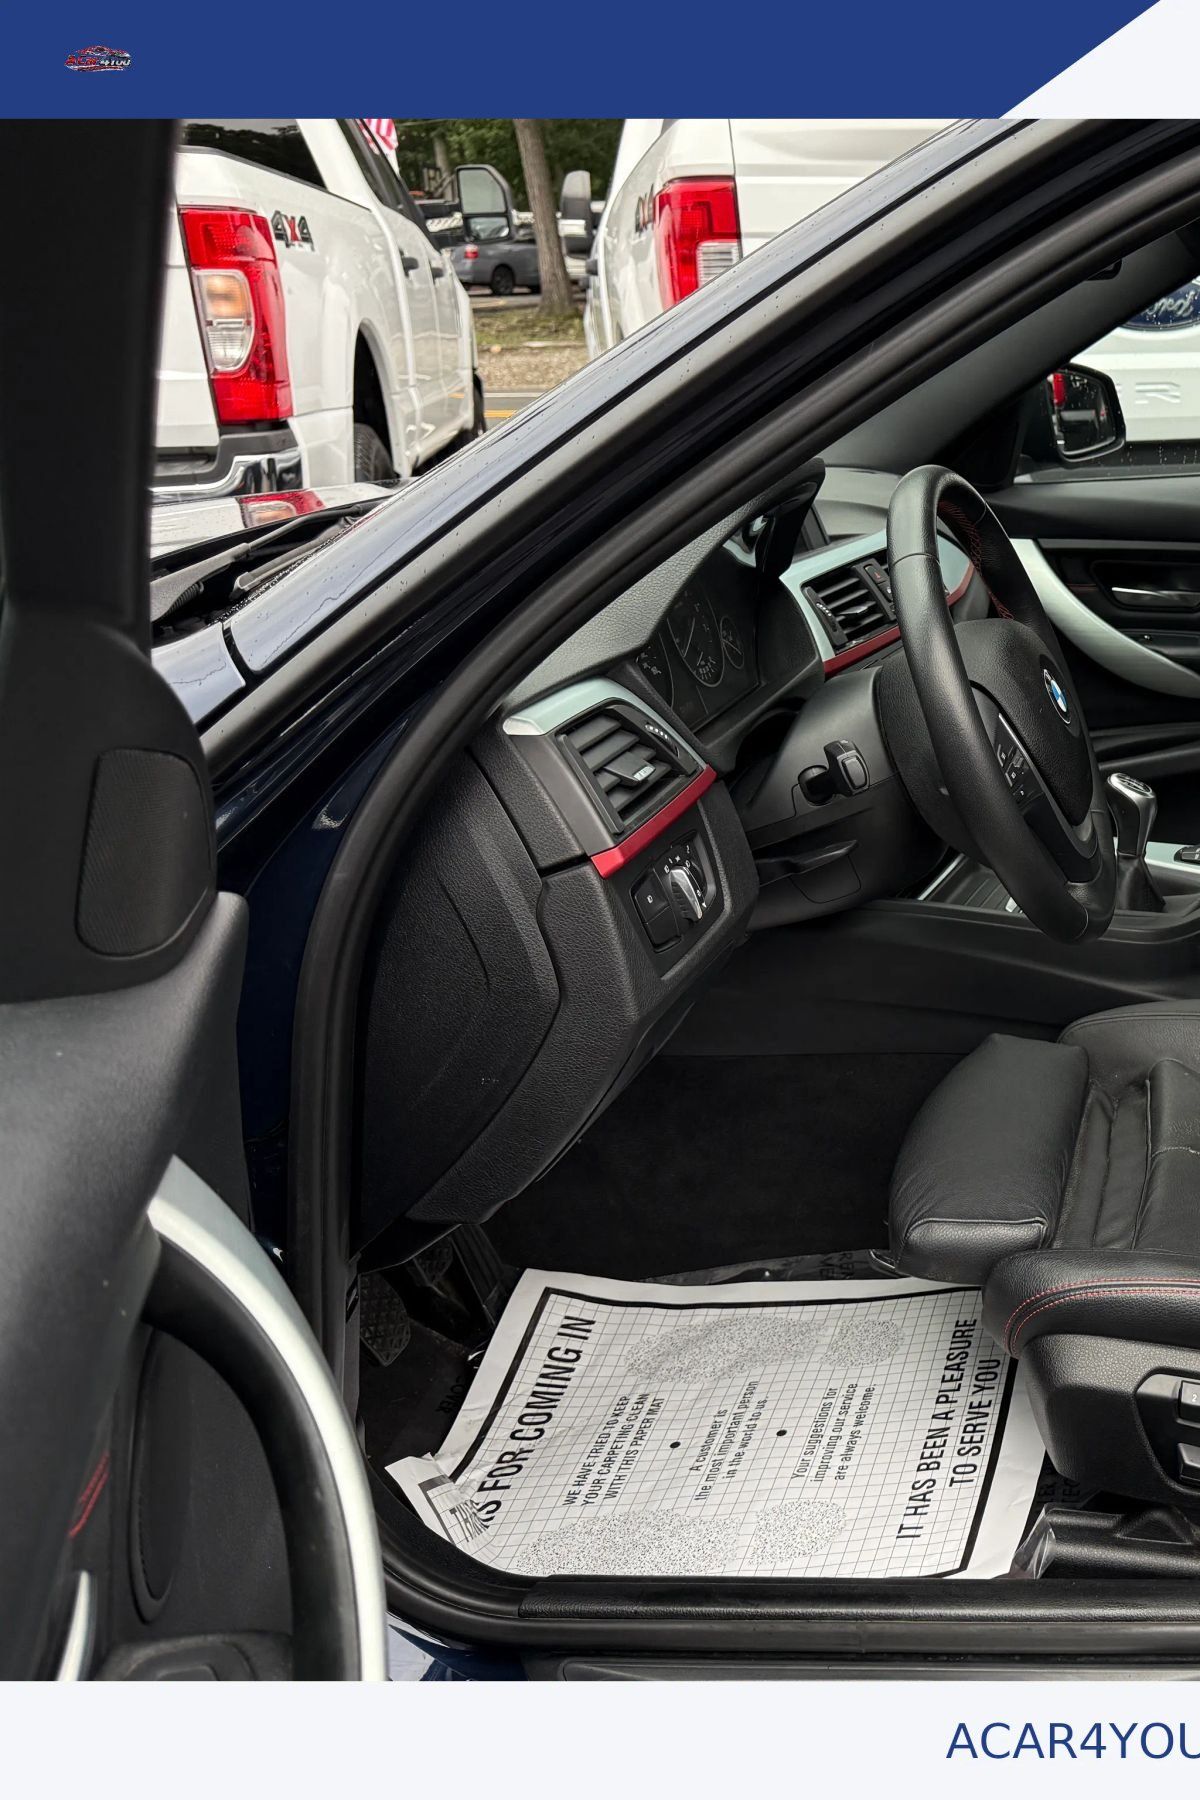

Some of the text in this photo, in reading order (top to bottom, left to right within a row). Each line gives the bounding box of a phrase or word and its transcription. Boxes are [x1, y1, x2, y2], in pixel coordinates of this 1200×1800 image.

[477, 1448, 534, 1492] FOR
[510, 1347, 583, 1440] COMING
[557, 1316, 596, 1340] IN
[603, 1398, 665, 1499] WITH THIS PAPER MAT
[694, 1381, 759, 1501] the most important person
[696, 1420, 723, 1465] customer
[713, 1409, 728, 1418] is
[722, 1396, 769, 1479] in the world to us.
[791, 1387, 838, 1479] Your suggestions for
[810, 1383, 858, 1482] improving our service
[834, 1384, 877, 1481] are always welcome.
[896, 1318, 977, 1539] IT HAS BEEN A PLEASURE
[949, 1359, 1001, 1487] TO SERVE YOU
[1192, 1394, 1198, 1402] 2
[562, 1396, 630, 1505] WE HAVE TRIED TO KEEP
[581, 1393, 650, 1506] YOUR CARPETING CLEAN
